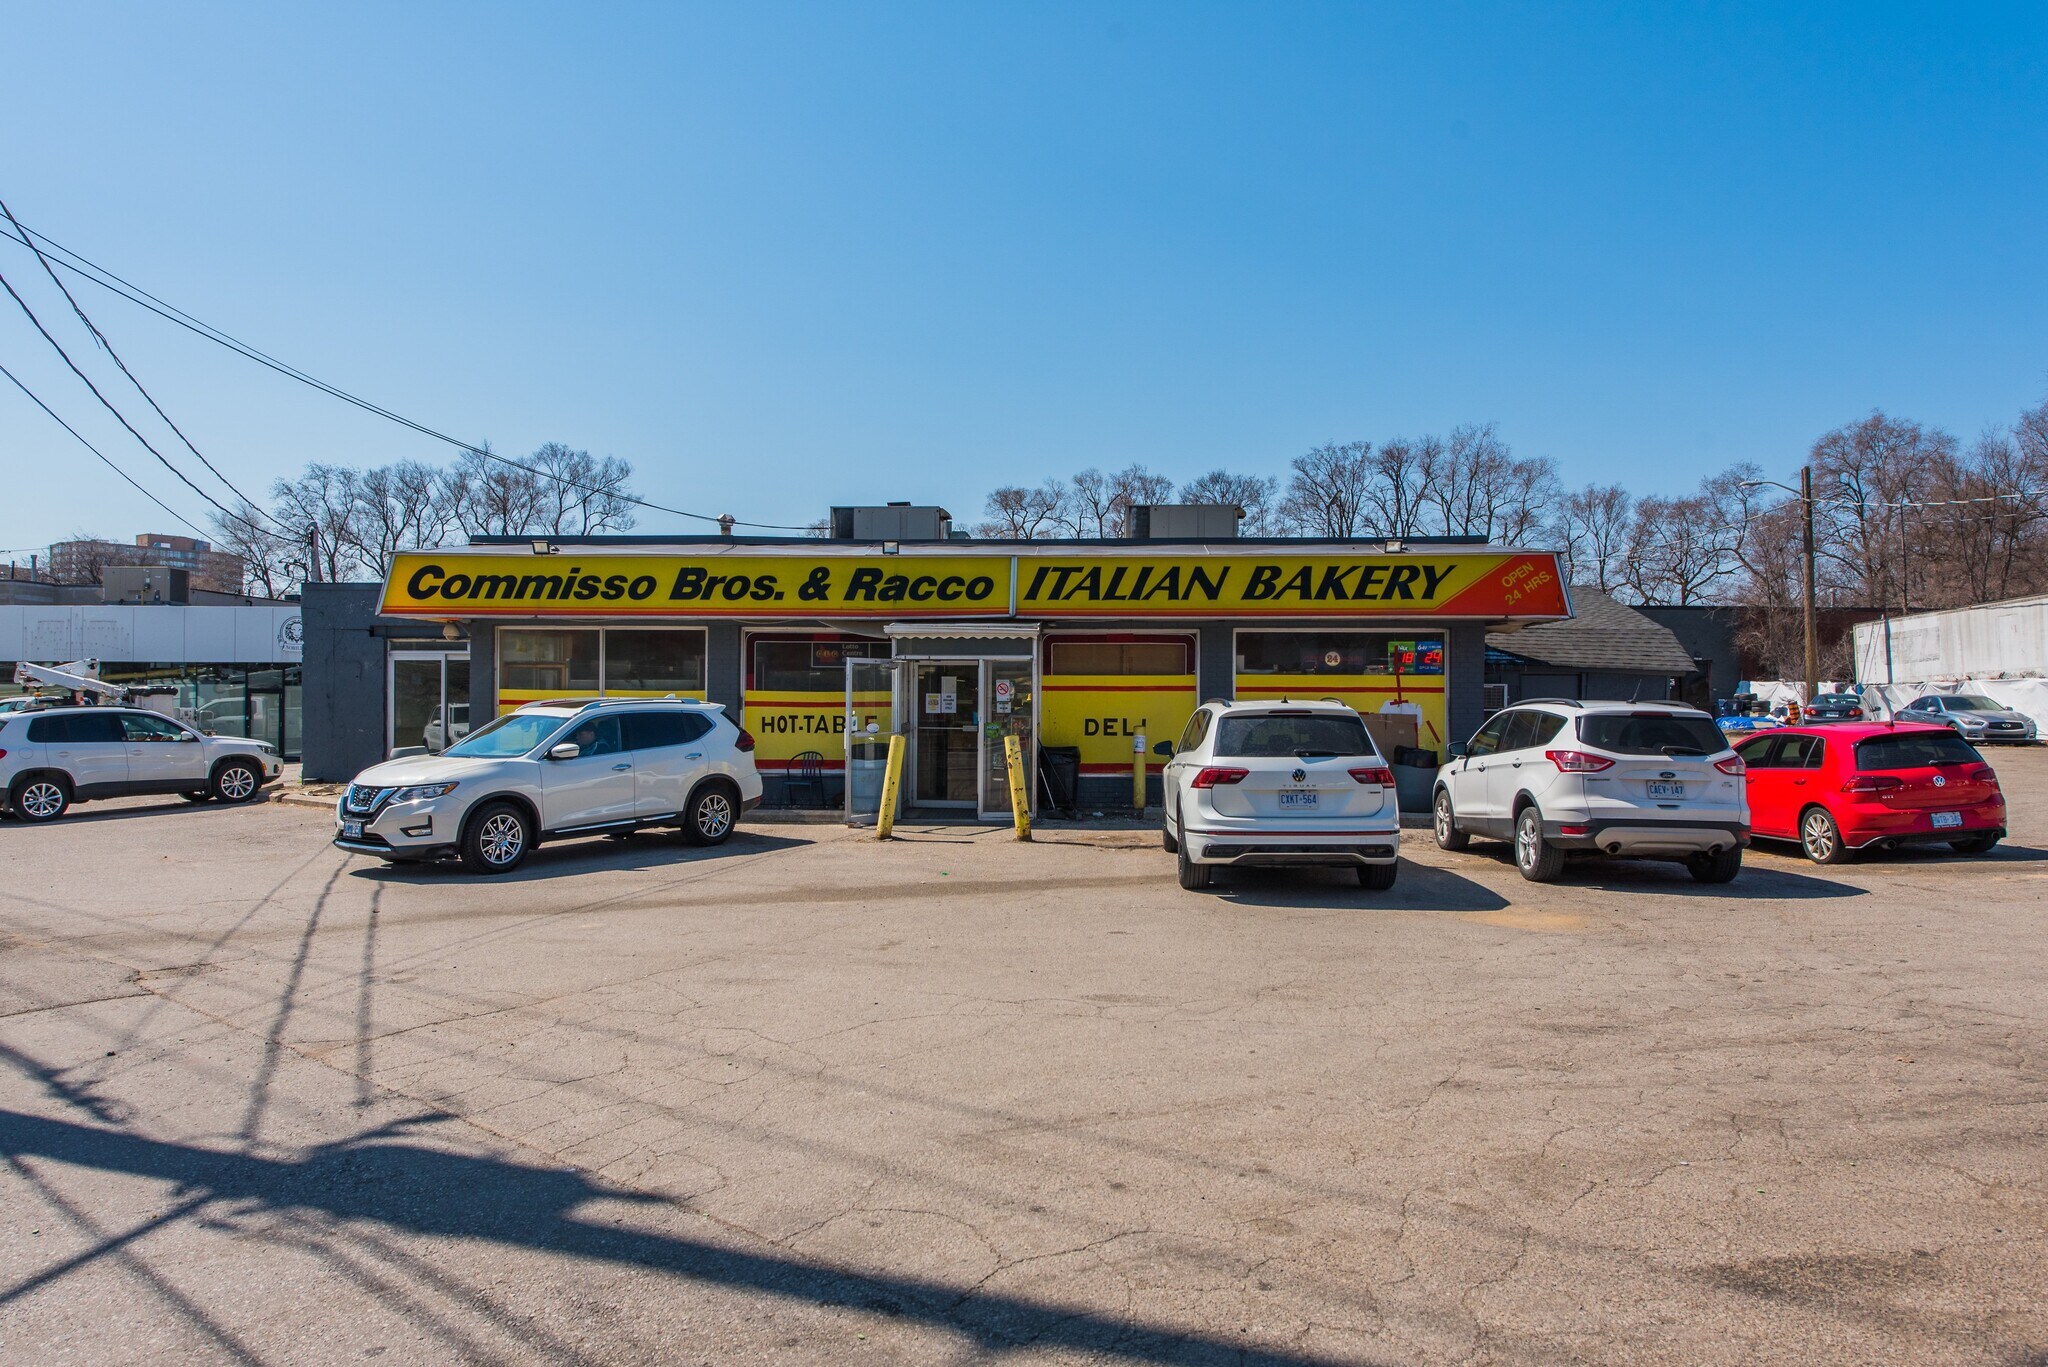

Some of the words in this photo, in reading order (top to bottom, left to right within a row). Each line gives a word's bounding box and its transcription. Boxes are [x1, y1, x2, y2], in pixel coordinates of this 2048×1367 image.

[407, 565, 657, 600] Commisso
[669, 567, 785, 600] Bros.
[798, 566, 831, 601] &
[843, 567, 994, 601] Racco
[1023, 566, 1230, 600] ITALIAN
[1241, 565, 1457, 600] BAKERY
[1502, 562, 1534, 587] OPEN
[1505, 589, 1522, 606] 24
[1523, 571, 1553, 593] HRS.
[1327, 654, 1338, 663] 24
[1424, 651, 1441, 664] 24
